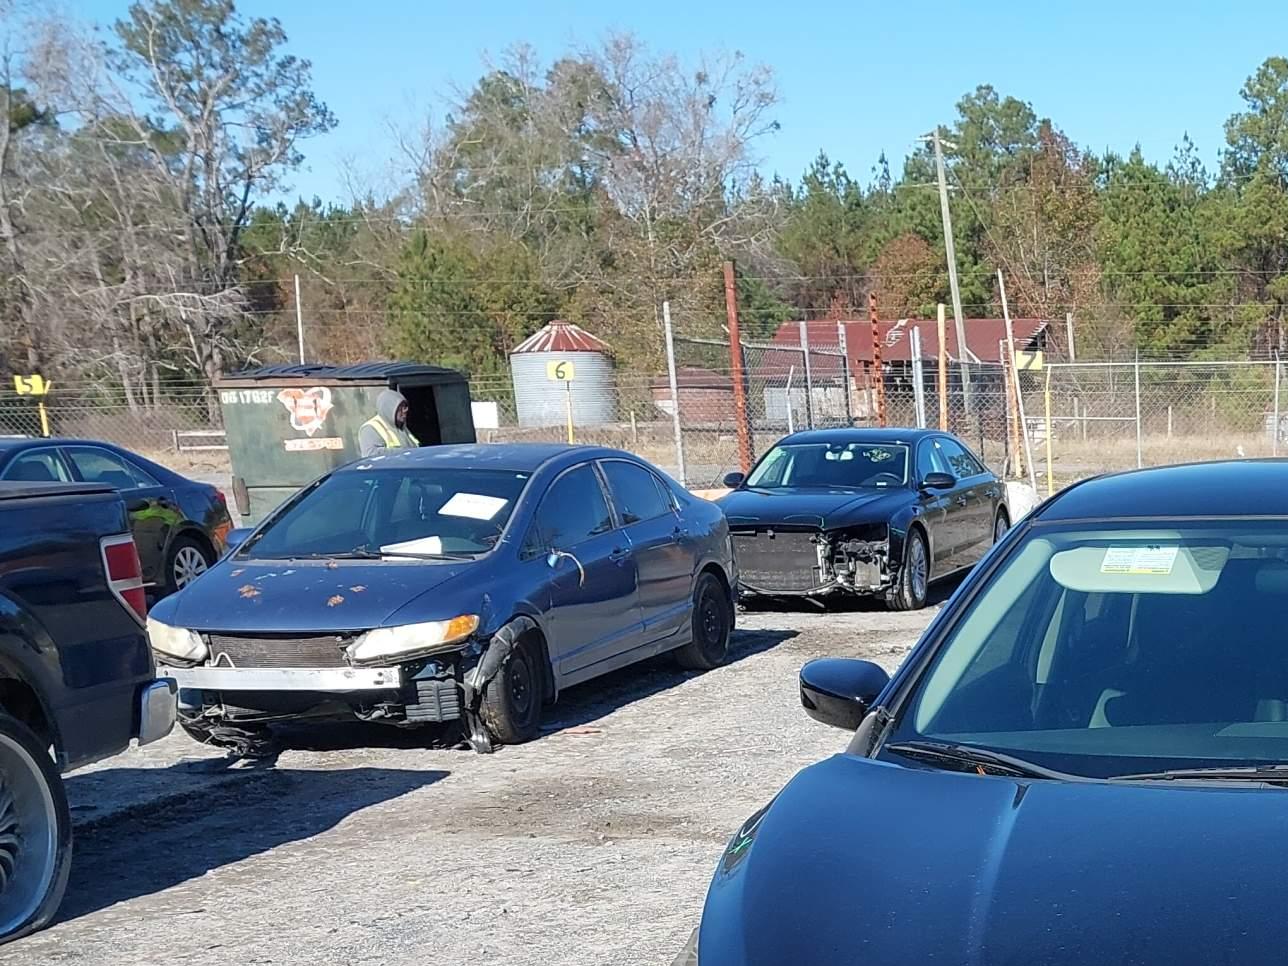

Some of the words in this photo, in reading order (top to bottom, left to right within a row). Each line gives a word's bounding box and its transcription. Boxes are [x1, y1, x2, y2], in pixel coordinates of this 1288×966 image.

[1022, 351, 1037, 369] 7
[555, 361, 567, 379] 6
[21, 376, 33, 394] 5
